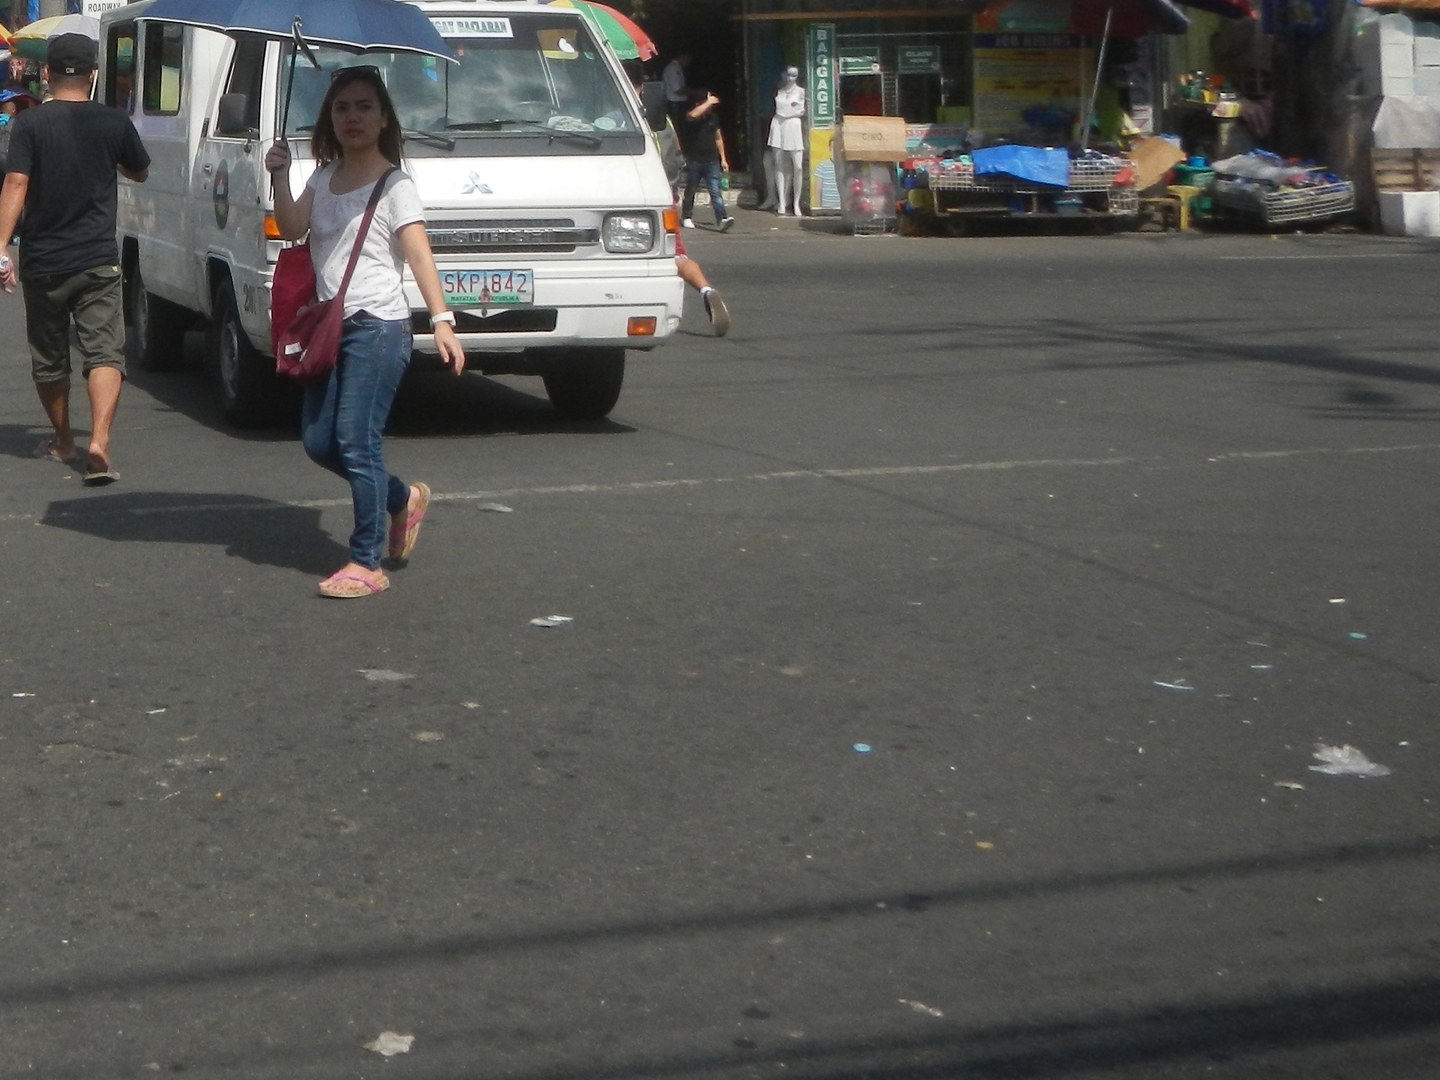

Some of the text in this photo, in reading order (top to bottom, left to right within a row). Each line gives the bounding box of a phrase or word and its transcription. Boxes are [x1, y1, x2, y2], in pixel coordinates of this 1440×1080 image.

[816, 29, 828, 115] BAGGAGE
[444, 270, 528, 294] SKP 842
